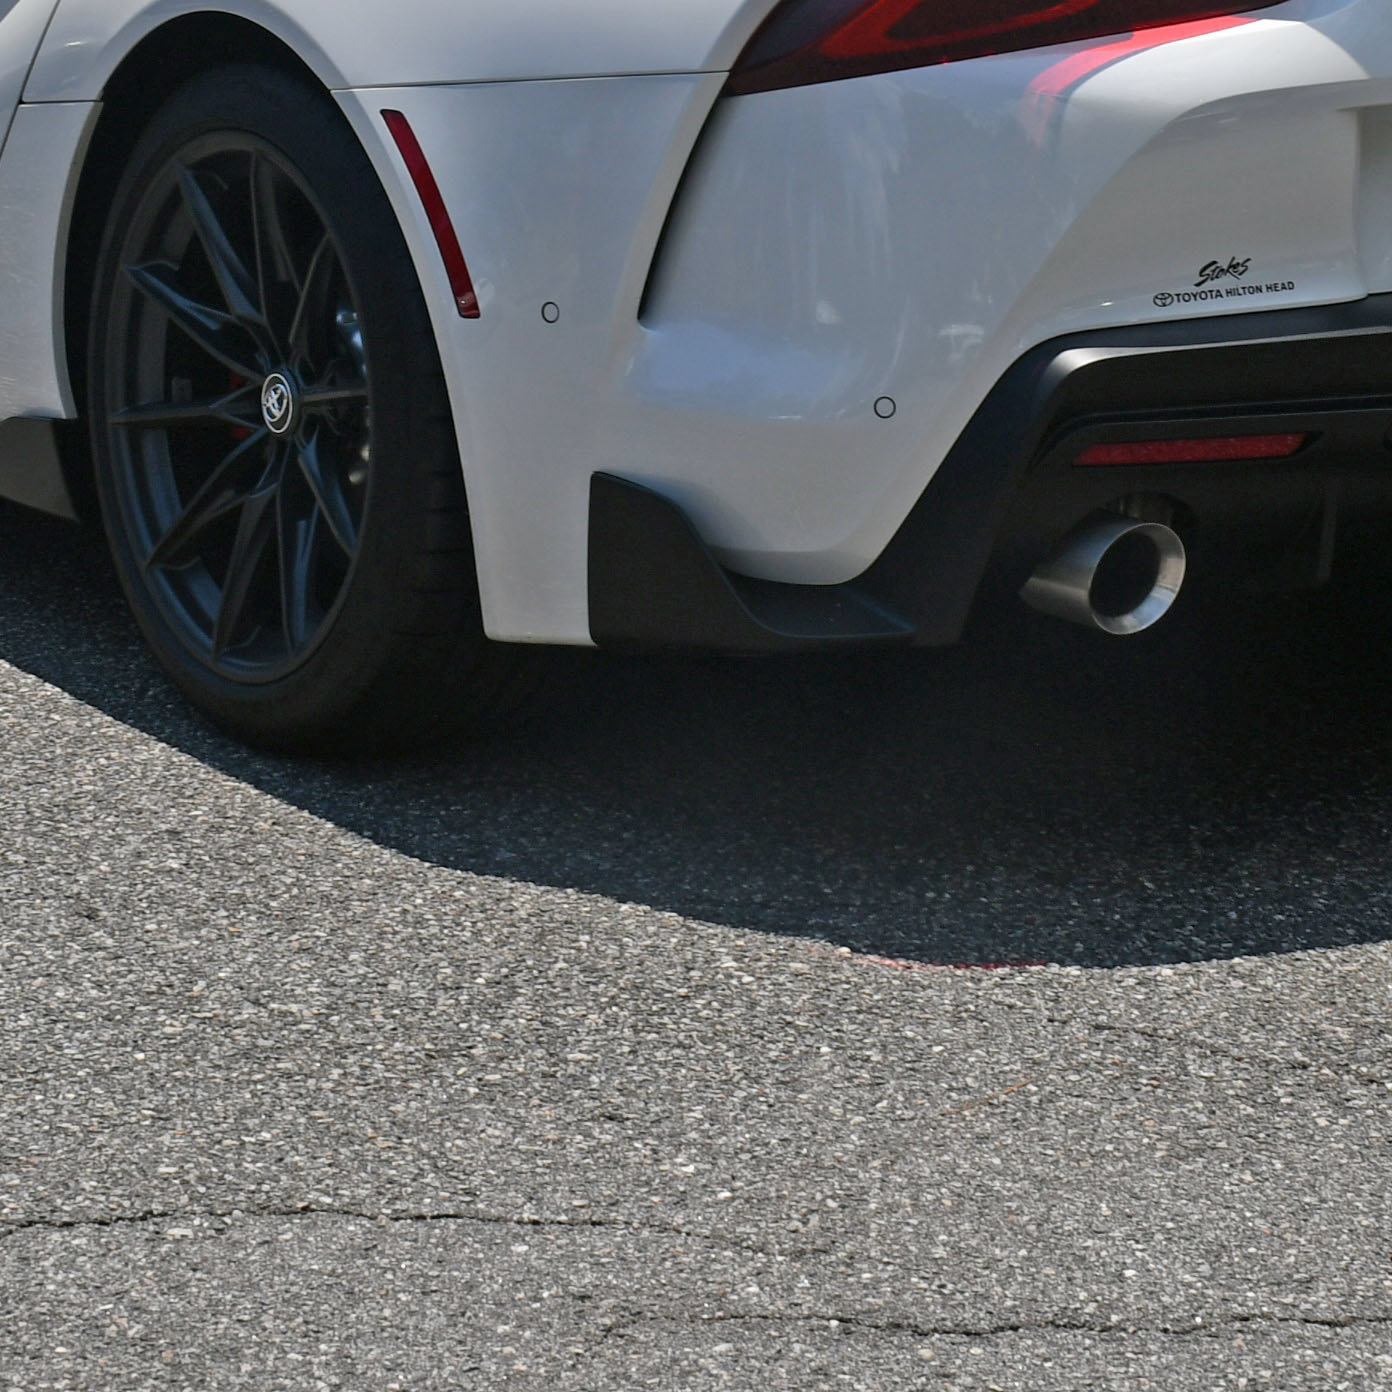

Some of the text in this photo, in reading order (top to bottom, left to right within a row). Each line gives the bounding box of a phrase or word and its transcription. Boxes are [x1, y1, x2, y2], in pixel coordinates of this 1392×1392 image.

[1193, 256, 1251, 287] Stokes
[1174, 281, 1295, 303] TOYOTA HILTON HEAD
